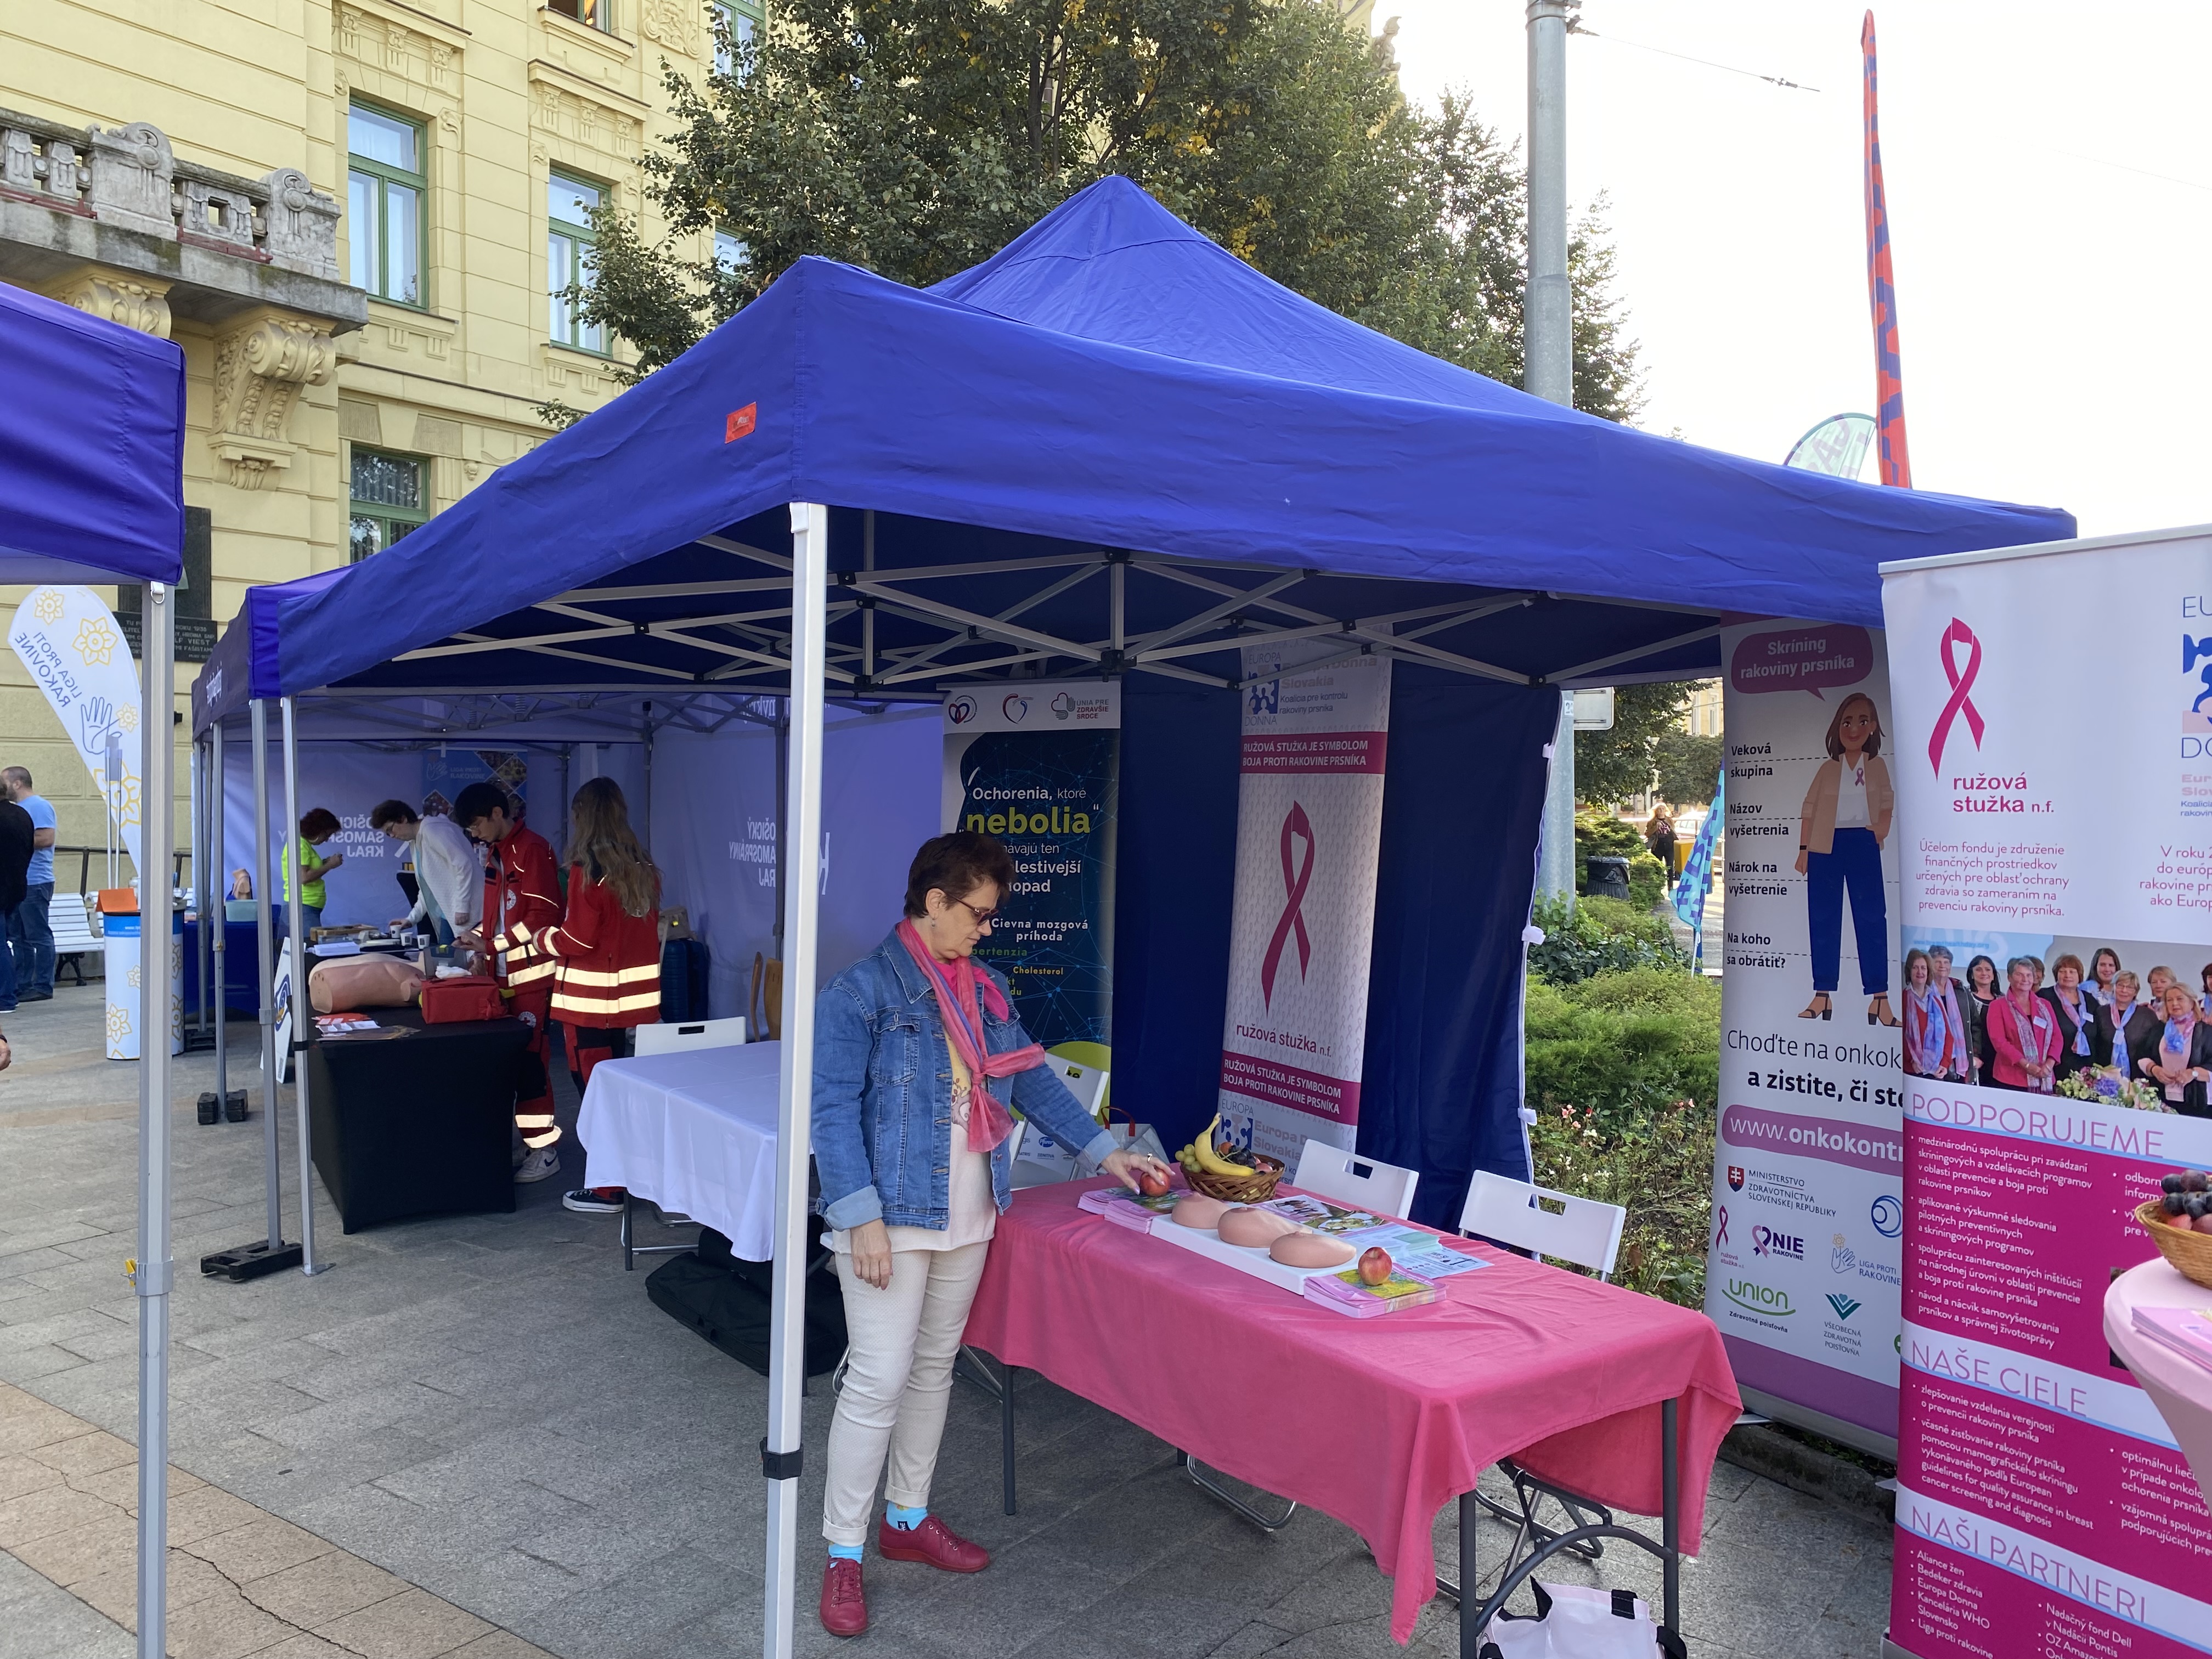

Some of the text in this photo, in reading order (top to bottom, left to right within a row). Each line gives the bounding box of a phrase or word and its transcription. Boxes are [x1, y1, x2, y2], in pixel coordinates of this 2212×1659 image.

[1768, 639, 1826, 654] Skríning
[1249, 652, 1281, 664] EUROPA
[1741, 656, 1854, 679] rakoviny prsníka
[1280, 676, 1334, 689] Slovakia
[1280, 694, 1306, 703] Koalícia
[1320, 691, 1347, 700] kontrolu
[1279, 704, 1333, 715] rakoviny prsníka
[1244, 715, 1277, 726] DONNA
[1243, 740, 1368, 753] RUŽOVÁ STUŽKA JE SYMBOLOM
[1731, 743, 1771, 756] Veková
[1243, 754, 1366, 766] BOJA PROTI RAKOVINE PRSNÍKA
[1731, 765, 1773, 778] skupina
[1953, 772, 2028, 791] ružová
[972, 786, 1086, 801] Ochorenia, ktoré
[1730, 803, 1762, 814] Názov
[1953, 795, 2055, 813] stužka n.f.
[1730, 825, 1788, 837] vyšetrenia
[1041, 843, 1059, 854] ten
[1920, 838, 2064, 856] Účelom fondu je združenie
[2160, 845, 2204, 858] V roku
[1729, 861, 1778, 873] Nárok na
[1925, 855, 2057, 872] finančných prostriedkov
[2157, 861, 2173, 873] do
[1916, 871, 2069, 889] určených pre oblasť ochrany
[2140, 877, 2194, 891] rakovine
[1729, 884, 1787, 896] vyšetrenie
[1925, 885, 1959, 898] zdravia
[1962, 889, 1974, 898] so
[1978, 888, 2040, 900] zameraním
[2150, 893, 2172, 906] ako
[1918, 901, 2064, 917] prevenciu rakoviny prsníka.
[991, 918, 1088, 932] Cievna mozgová
[1016, 931, 1062, 942] príhoda
[1728, 933, 1771, 945] Na koho
[1727, 955, 1785, 968] sa obrátiť?
[1237, 1023, 1331, 1057] ružová stužka n.f.
[1728, 1030, 1798, 1056] Choďte
[1804, 1042, 1828, 1060] na
[1224, 1059, 1341, 1098] RUŽOVÁ STUŽKA JE SYMBOLOM
[1748, 1071, 1759, 1086] a
[1767, 1069, 1842, 1102] zistite,
[1849, 1080, 1867, 1102] či
[1223, 1074, 1340, 1114] BOJA PROTI RAKOVINE PRSNÍKA
[1222, 1098, 1254, 1116] EUROPA
[1254, 1120, 1297, 1143] Europa
[1912, 1093, 2164, 1159] PODPORUJEME
[1918, 1135, 2087, 1173] medzinárodnú spoluprácu pri zavádzaní
[1918, 1149, 1975, 1168] skríningových
[1985, 1160, 2040, 1179] vzdelávacích
[2043, 1172, 2092, 1189] programov
[1749, 1170, 1804, 1187] MINISTERSTVO
[1749, 1183, 1814, 1204] ZDRAVOTNÍCTVA
[1749, 1193, 1836, 1217] SLOVENSKEJ REPUBLIKY
[1773, 1232, 1804, 1254] NIE
[1720, 1251, 1738, 1260] ružová
[1720, 1259, 1737, 1267] stužka
[1773, 1249, 1803, 1261] RAKOVINE
[1859, 1260, 1896, 1274] LIGA PROTI
[1859, 1268, 1901, 1285] RAKOVINE
[1729, 1311, 1788, 1333] Zdravotná poisťovňa
[1824, 1321, 1861, 1337] VŠEOBECNÁ
[1824, 1331, 1861, 1347] ZDRAVOTNÁ
[1825, 1341, 1860, 1356] POISŤOVŇA
[1912, 1340, 2087, 1417] NAŠE CIELE
[1921, 1385, 2055, 1434] zlepšovanie vzdelania verejnosti
[2121, 1481, 2209, 1515] ochorenia prsníka
[1912, 1505, 2146, 1623] NAŠI PARTNERI
[1917, 1550, 1964, 1576] Aliance žen
[1918, 1565, 1983, 1598] Bedeker zdravia
[1918, 1578, 1978, 1610] Europa Donna
[1918, 1592, 1990, 1629] Kancelária WHO
[1918, 1605, 1959, 1630] Slovensko
[2046, 1602, 2131, 1648] Nadačný fond Dell
